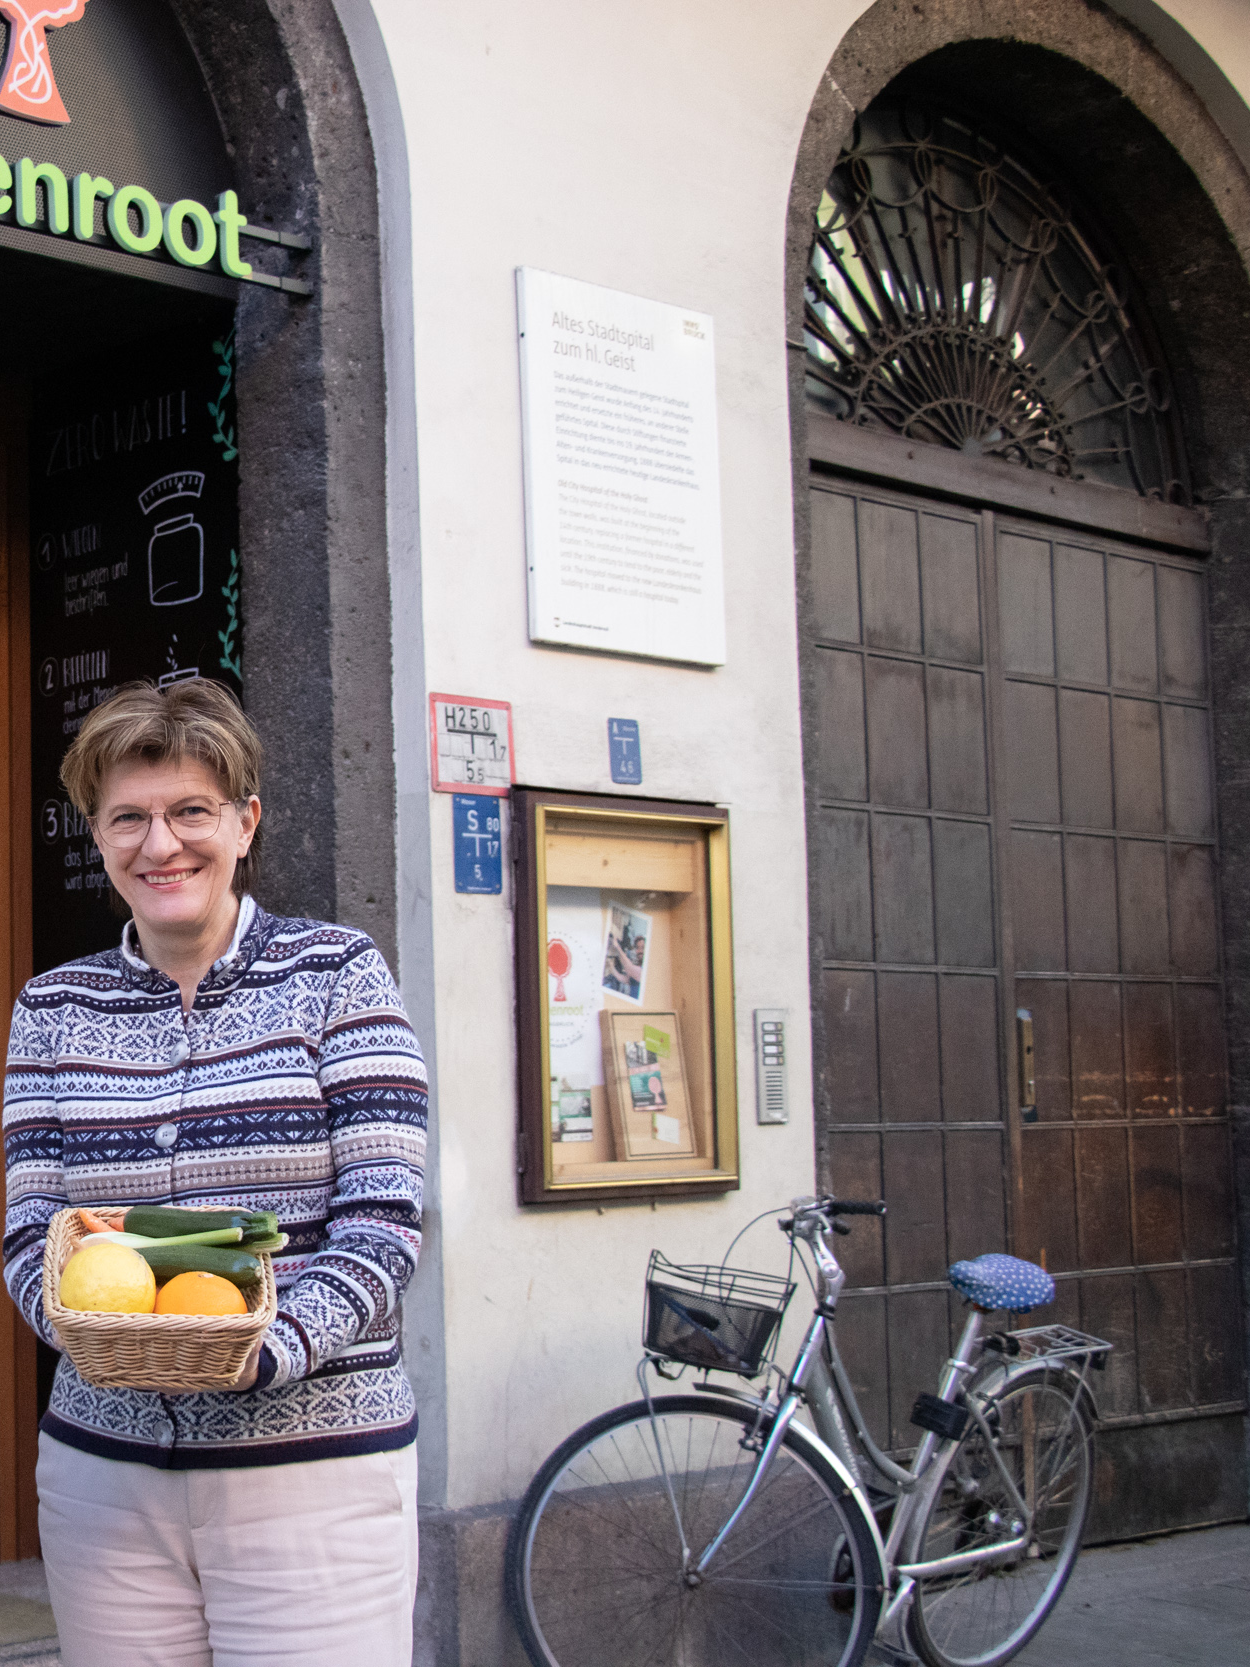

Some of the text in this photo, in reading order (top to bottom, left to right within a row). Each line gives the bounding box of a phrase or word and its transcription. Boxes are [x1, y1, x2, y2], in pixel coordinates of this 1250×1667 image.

[551, 310, 655, 352] Altes Stadtspital
[553, 340, 636, 372] zum hl. Geist
[46, 414, 104, 476] ZERO
[111, 551, 128, 580] und
[445, 706, 491, 731] H250
[467, 809, 500, 832] S 80
[64, 846, 82, 868] das
[487, 841, 499, 858] 17
[65, 872, 82, 890] wird
[474, 864, 482, 879] 5
